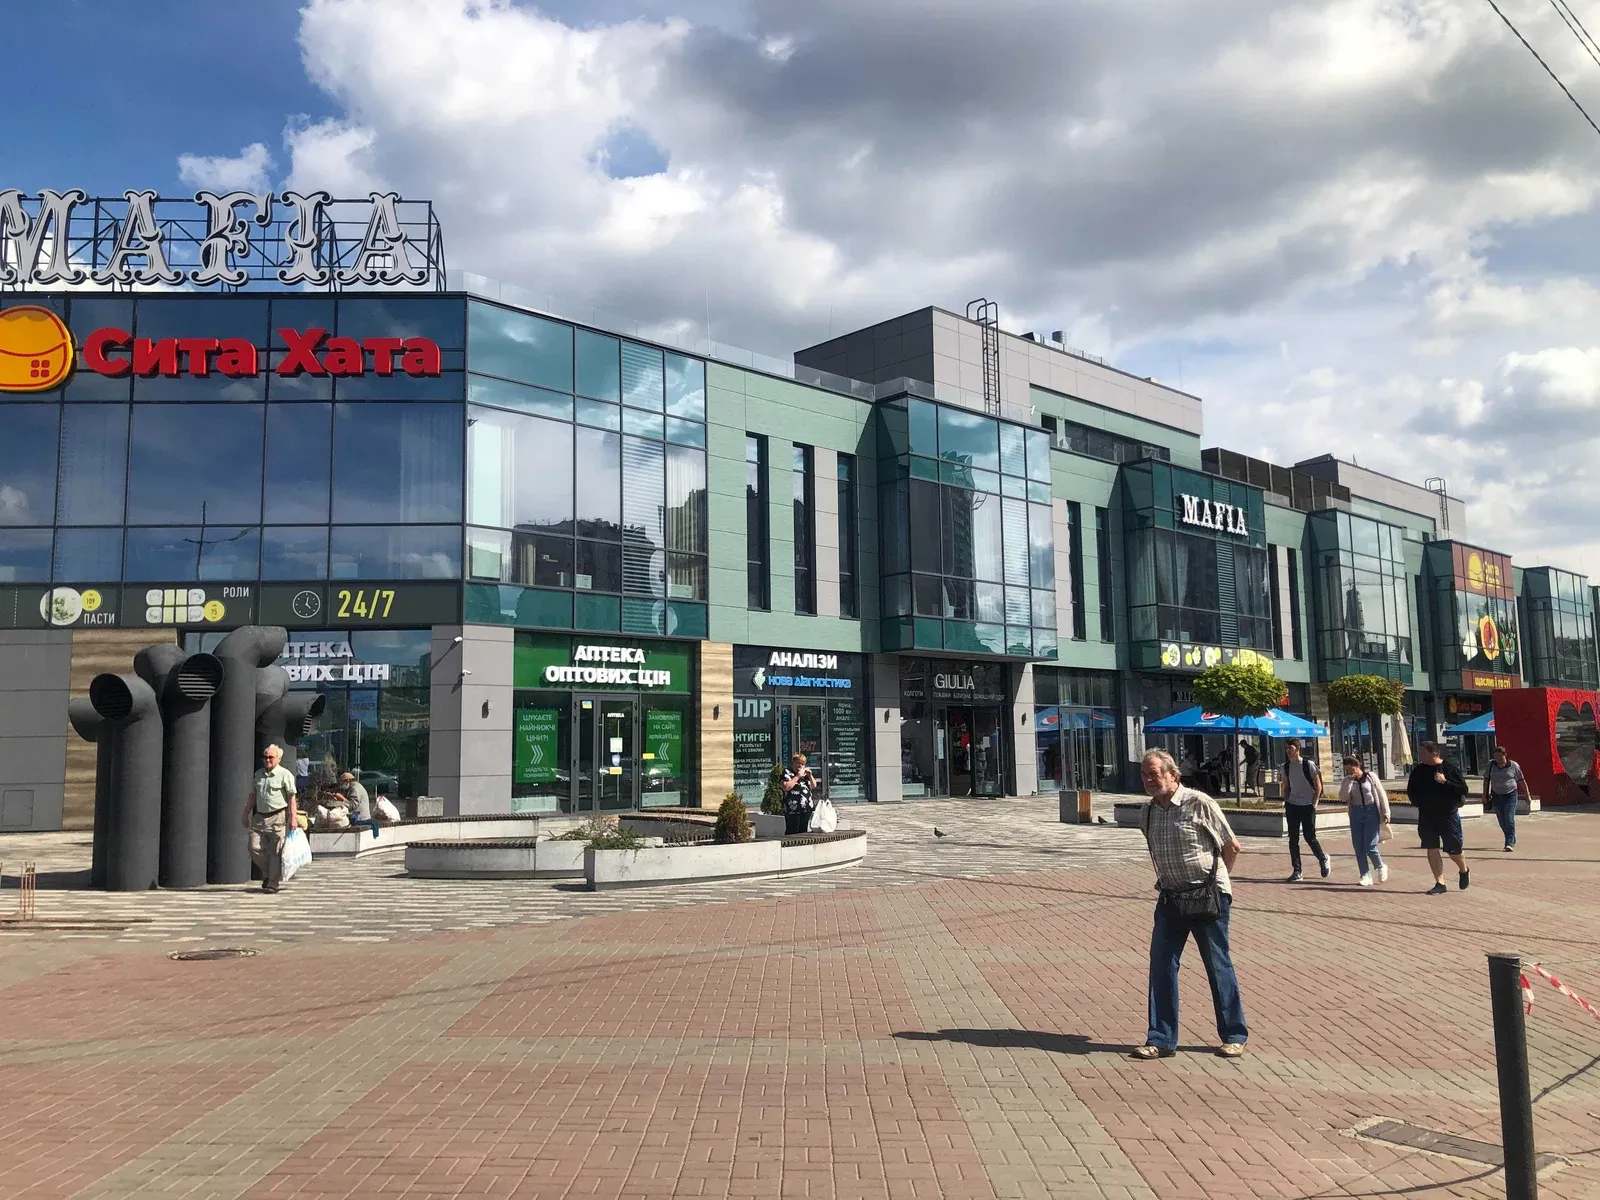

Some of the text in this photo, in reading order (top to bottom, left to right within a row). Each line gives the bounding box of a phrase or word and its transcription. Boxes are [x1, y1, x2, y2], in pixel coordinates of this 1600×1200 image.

[0, 189, 429, 286] MAFIA
[83, 327, 442, 376] Сита Хата
[1180, 493, 1248, 536] MAFIA
[223, 586, 250, 598] РОЛИ
[337, 590, 396, 619] 24/7
[83, 613, 115, 625] ПАСТИ
[279, 641, 353, 658] ТЕКА
[574, 645, 646, 664] АПТЕКА
[769, 651, 838, 670] АНАЛІЗИ
[281, 664, 389, 684] ВИХ ЦІН
[545, 666, 671, 687] ОПТОВИХ ЦІН
[935, 673, 975, 690] GIULIA
[734, 733, 771, 742] НТИГЕН
